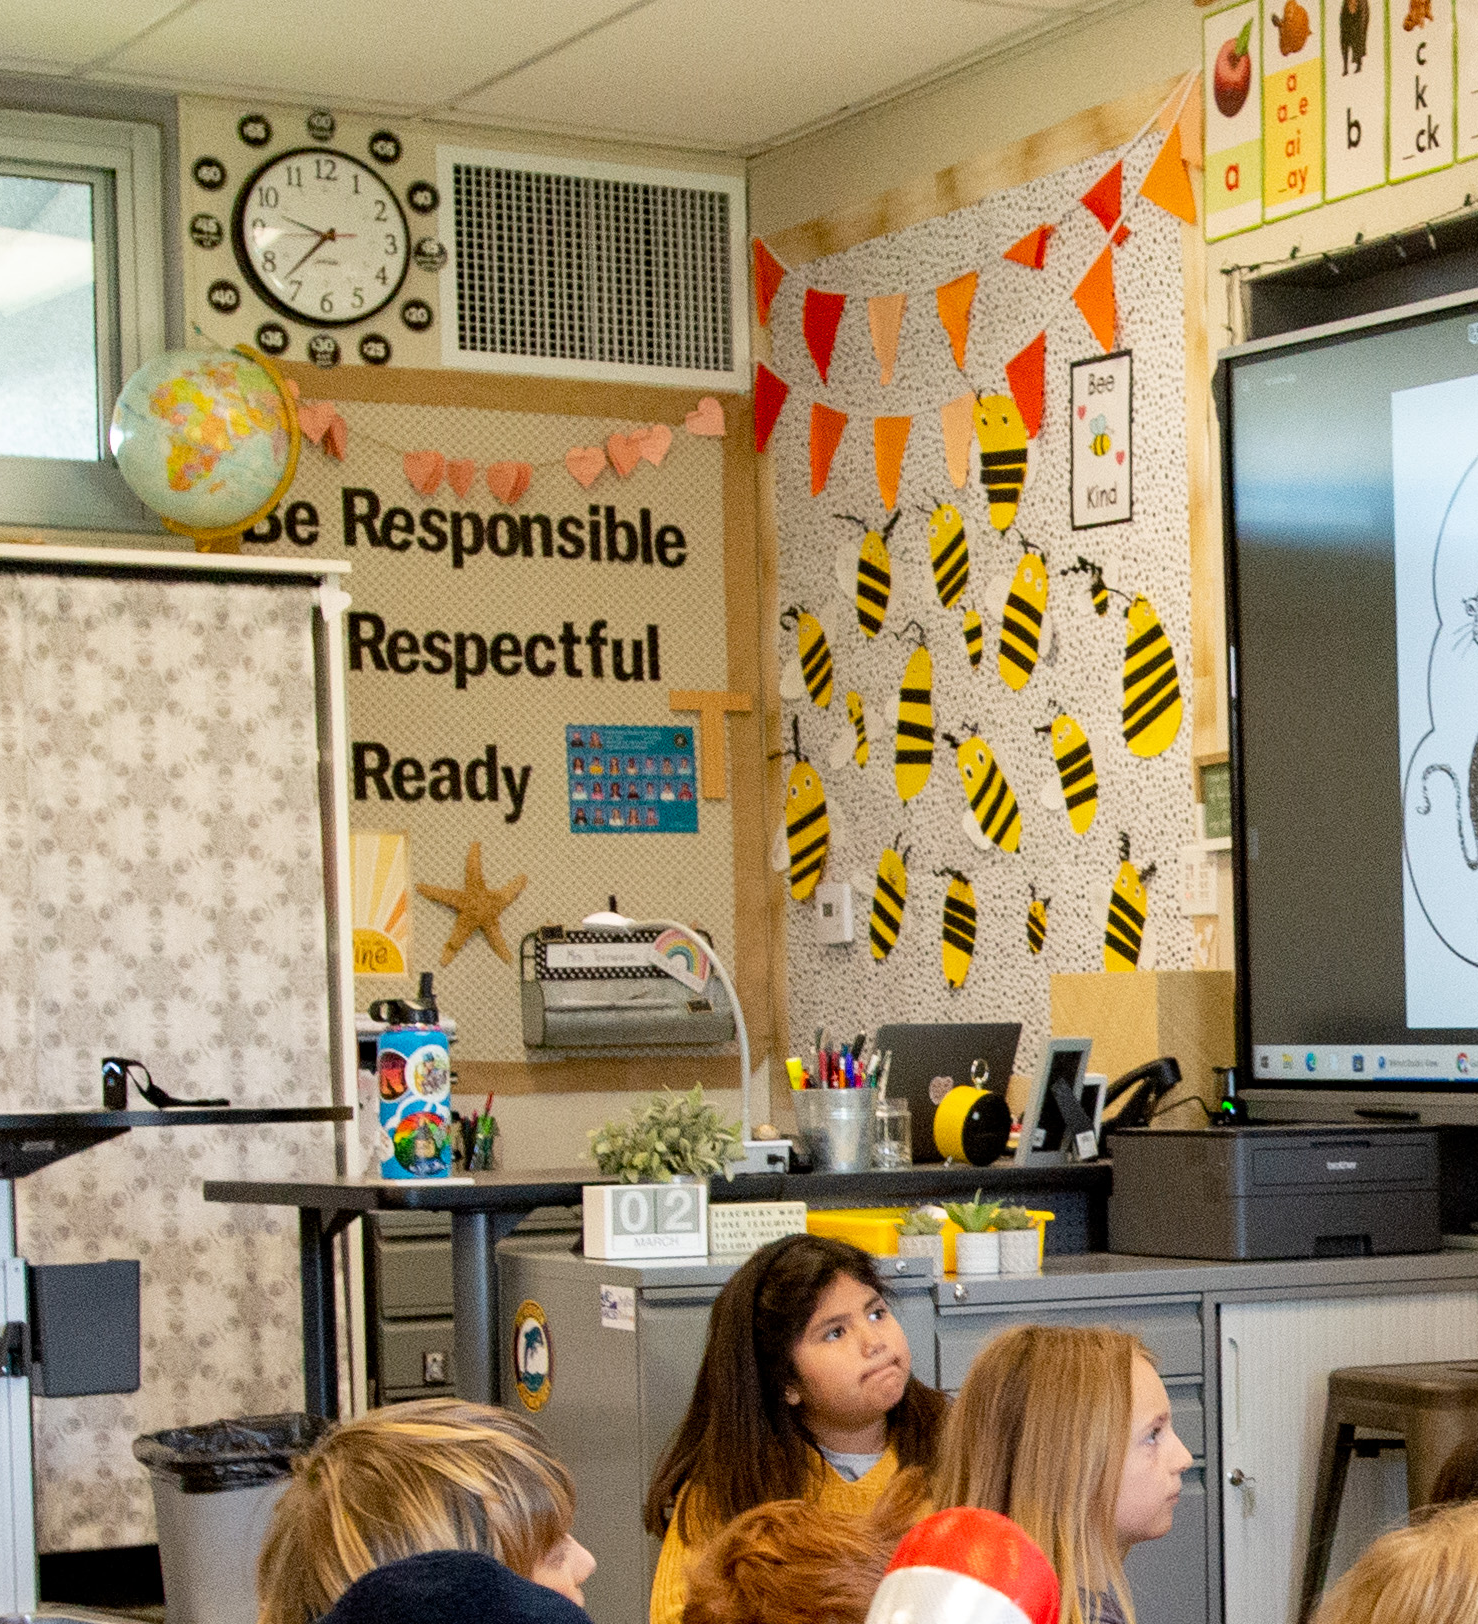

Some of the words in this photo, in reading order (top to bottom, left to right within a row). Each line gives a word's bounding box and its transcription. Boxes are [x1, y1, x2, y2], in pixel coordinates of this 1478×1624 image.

[1416, 42, 1427, 65] c
[1286, 73, 1297, 92] a
[1415, 75, 1428, 110] k
[1285, 129, 1301, 157] ai
[1347, 107, 1362, 149] b
[286, 166, 303, 187] 11
[314, 159, 337, 181] 12
[352, 174, 361, 194] 1
[1225, 164, 1240, 191] a
[257, 186, 279, 209] 10
[374, 200, 388, 222] 2
[384, 234, 397, 255] 3
[262, 250, 277, 272] 8
[375, 265, 388, 285] 4
[289, 279, 303, 301] 7
[320, 292, 333, 313] 6
[351, 287, 365, 308] 5
[1088, 373, 1116, 396] Bee
[1086, 483, 1118, 509] Kind
[341, 487, 688, 569] Responsible
[347, 610, 661, 689] Respectful
[352, 741, 532, 824] Ready
